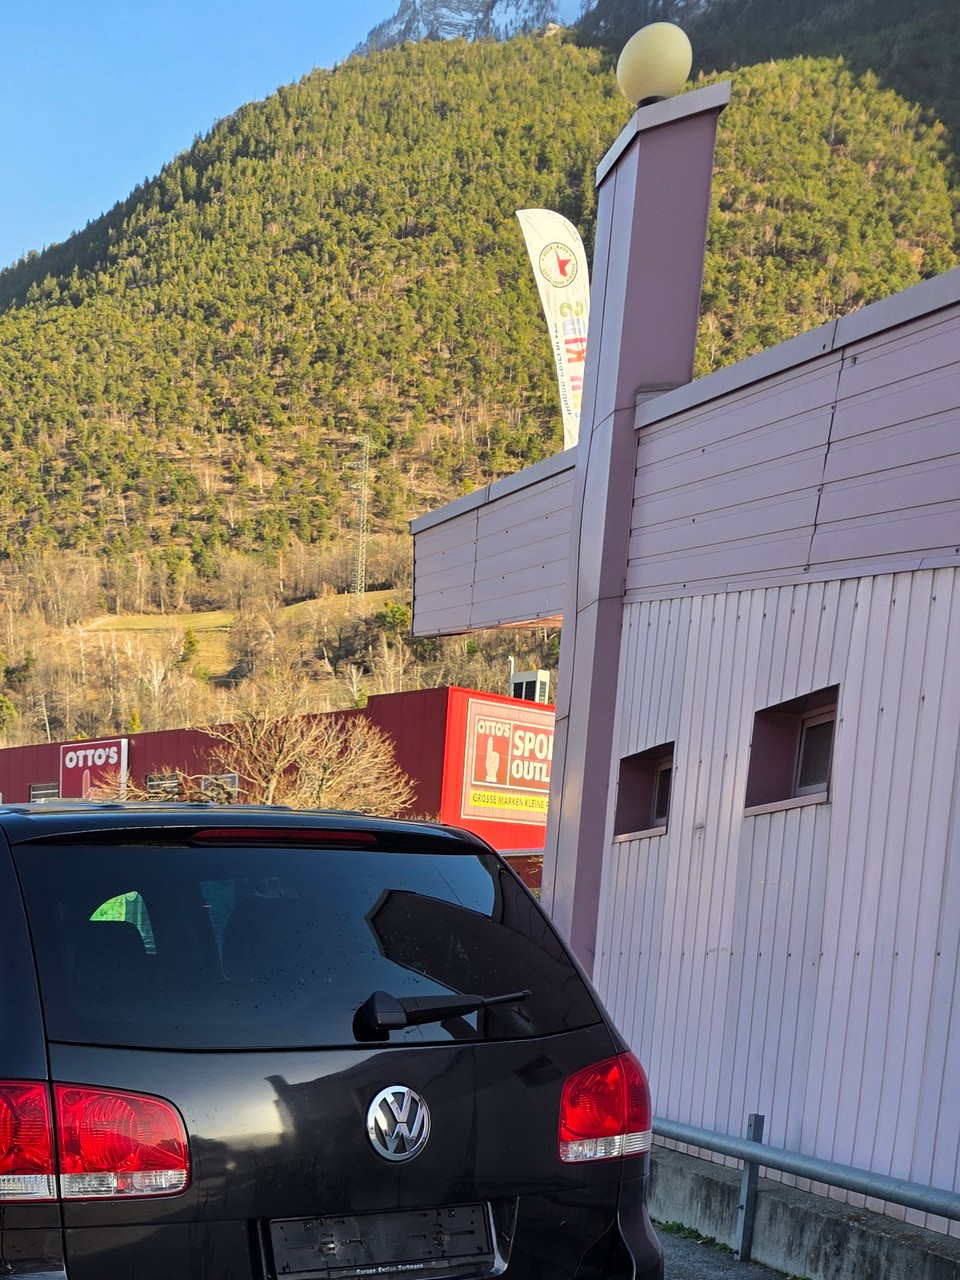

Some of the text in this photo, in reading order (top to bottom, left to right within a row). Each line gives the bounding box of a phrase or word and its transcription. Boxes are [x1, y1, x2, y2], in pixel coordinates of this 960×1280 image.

[477, 720, 511, 738] OTTO'S
[65, 746, 118, 769] OTTO'S
[472, 793, 497, 805] GROSSE
[498, 796, 524, 808] MARKEN
[524, 799, 545, 809] KLEINE
